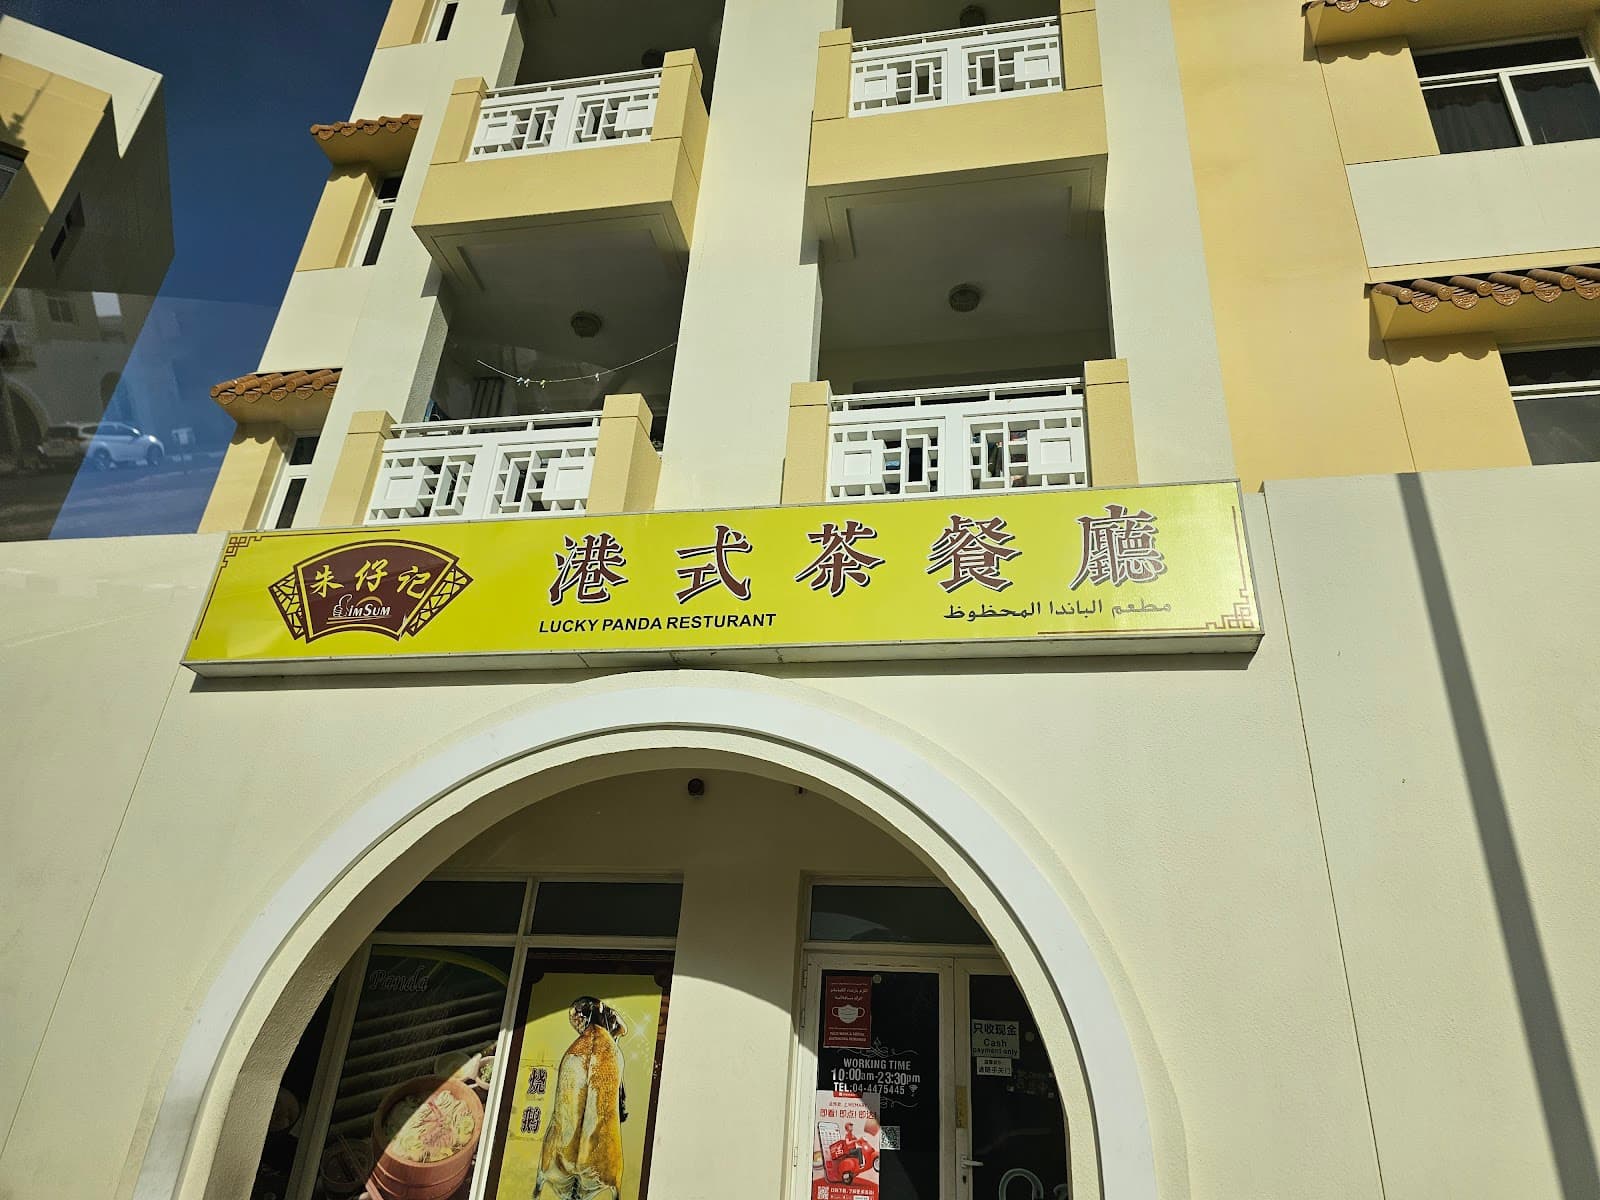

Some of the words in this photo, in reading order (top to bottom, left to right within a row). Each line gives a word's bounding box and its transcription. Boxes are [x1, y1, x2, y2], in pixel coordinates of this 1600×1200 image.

[549, 504, 1168, 606] 港式茶餐廳
[310, 558, 431, 599] 朱仔记
[944, 602, 1041, 622] المحظوظ
[1049, 599, 1102, 618] الباندا
[1111, 599, 1172, 617] مطعم
[539, 619, 598, 633] LUCKY
[602, 617, 662, 631] PANDA
[666, 614, 777, 629] RESTURANT
[974, 1023, 1017, 1036] 只收现金
[984, 1039, 1007, 1047] Cash
[844, 1058, 886, 1068] WORKING
[890, 1060, 911, 1071] TIME
